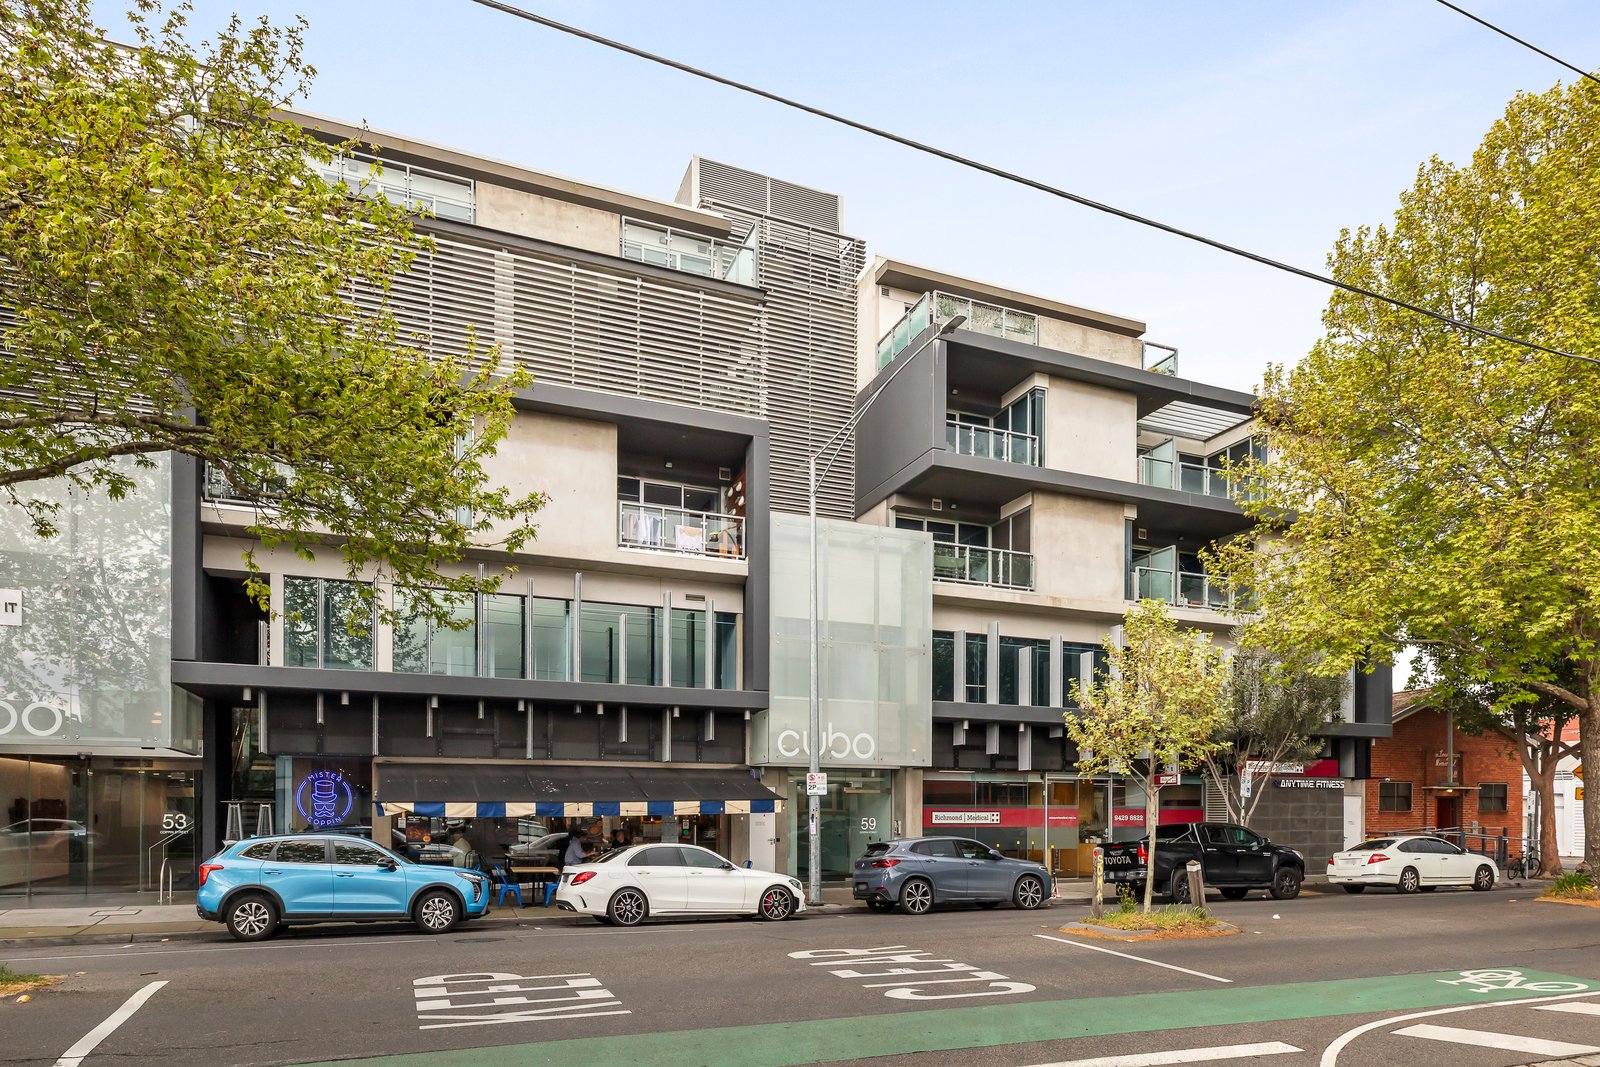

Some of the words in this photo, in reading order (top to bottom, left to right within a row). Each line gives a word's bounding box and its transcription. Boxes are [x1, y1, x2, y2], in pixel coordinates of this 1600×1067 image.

[4, 601, 18, 613] IT
[777, 722, 875, 758] cubo
[307, 771, 342, 783] MISTER
[1280, 779, 1315, 788] ANYTIME
[1316, 780, 1345, 789] FITNESS
[162, 813, 187, 829] 53
[307, 816, 342, 826] COPPIN
[860, 817, 876, 830] 59
[1104, 855, 1132, 865] TOYOTA
